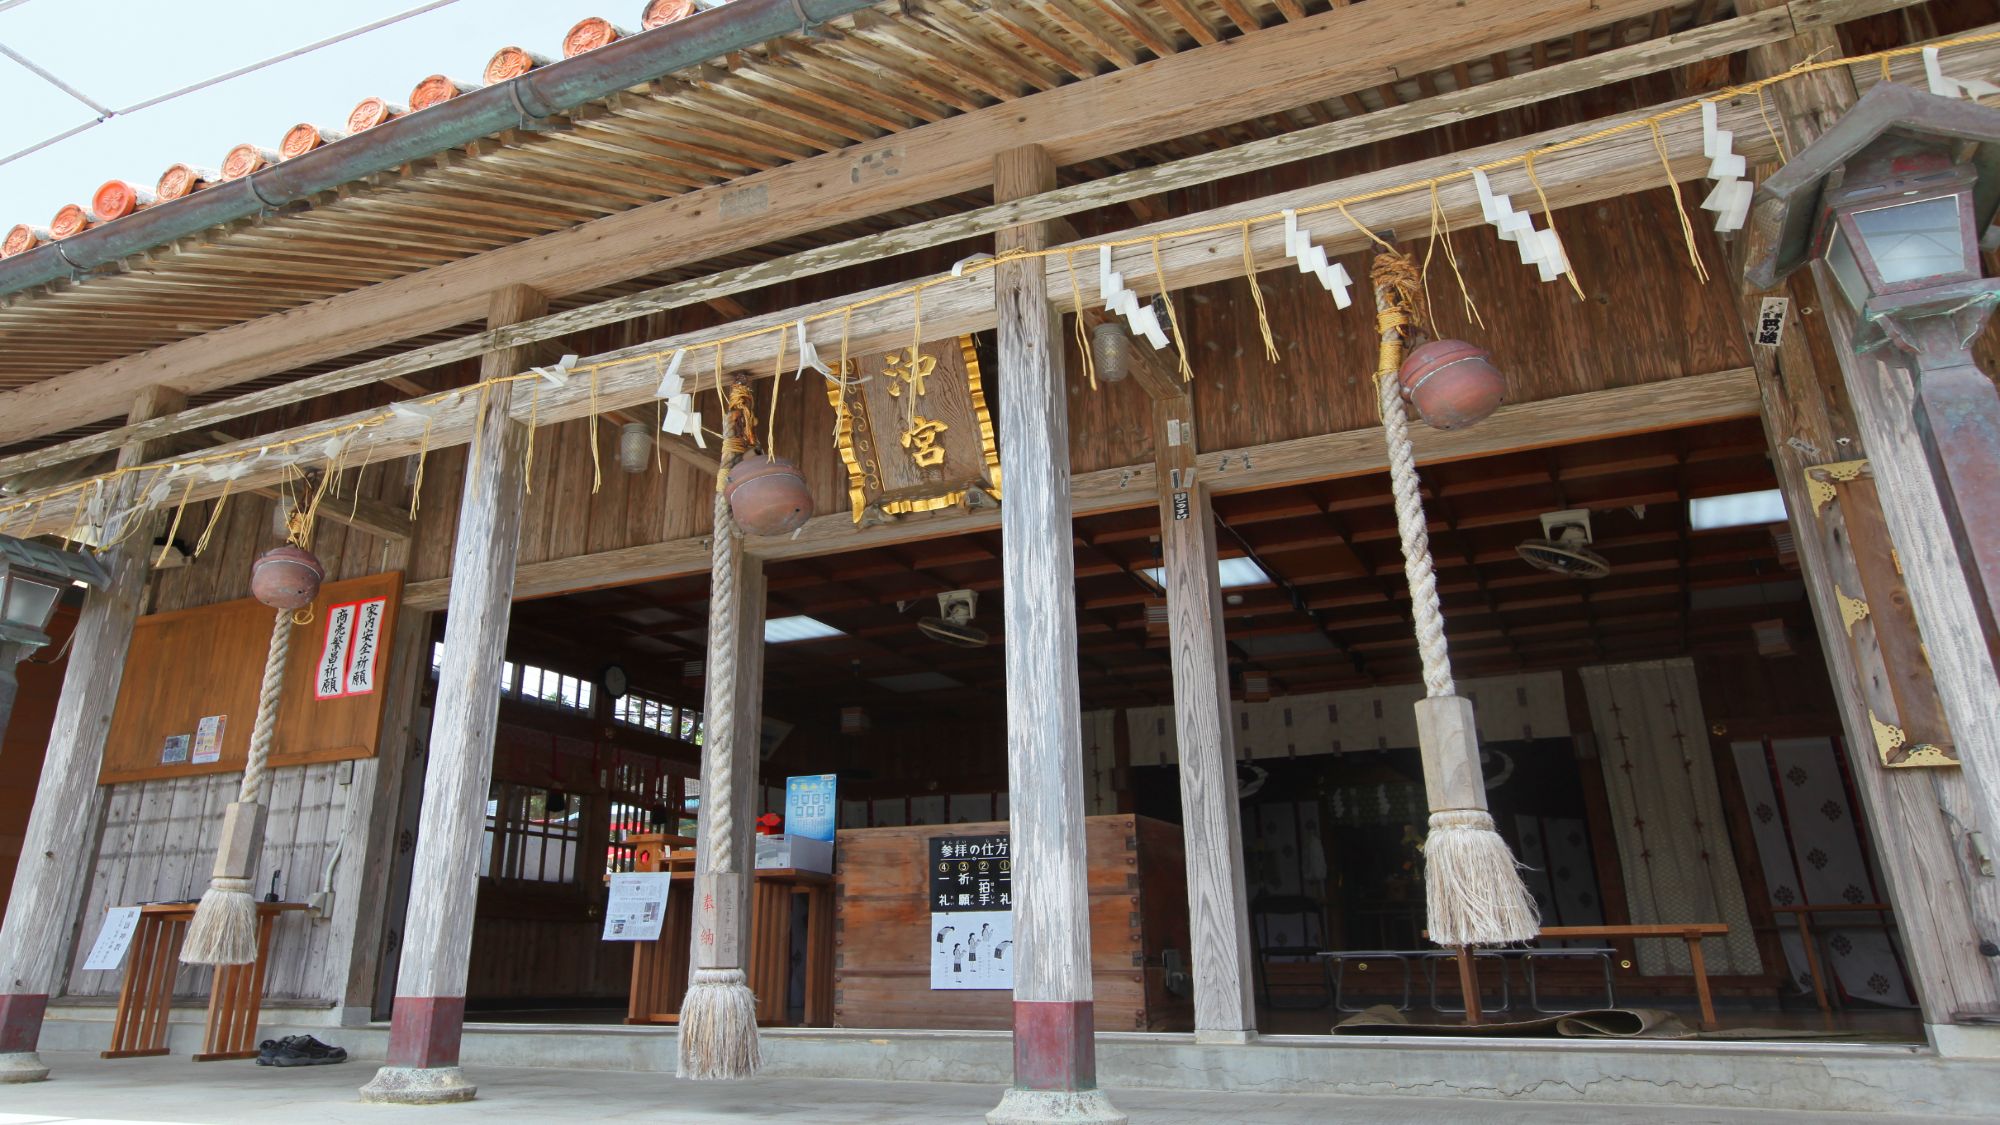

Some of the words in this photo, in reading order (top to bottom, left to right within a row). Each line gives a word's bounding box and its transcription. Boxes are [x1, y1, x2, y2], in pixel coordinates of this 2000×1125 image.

[321, 608, 348, 694] 商売繁昌祈願
[352, 603, 379, 686] 家内安全祈願
[941, 843, 1009, 858] 参拝の仕方
[700, 893, 715, 946] 奉納
